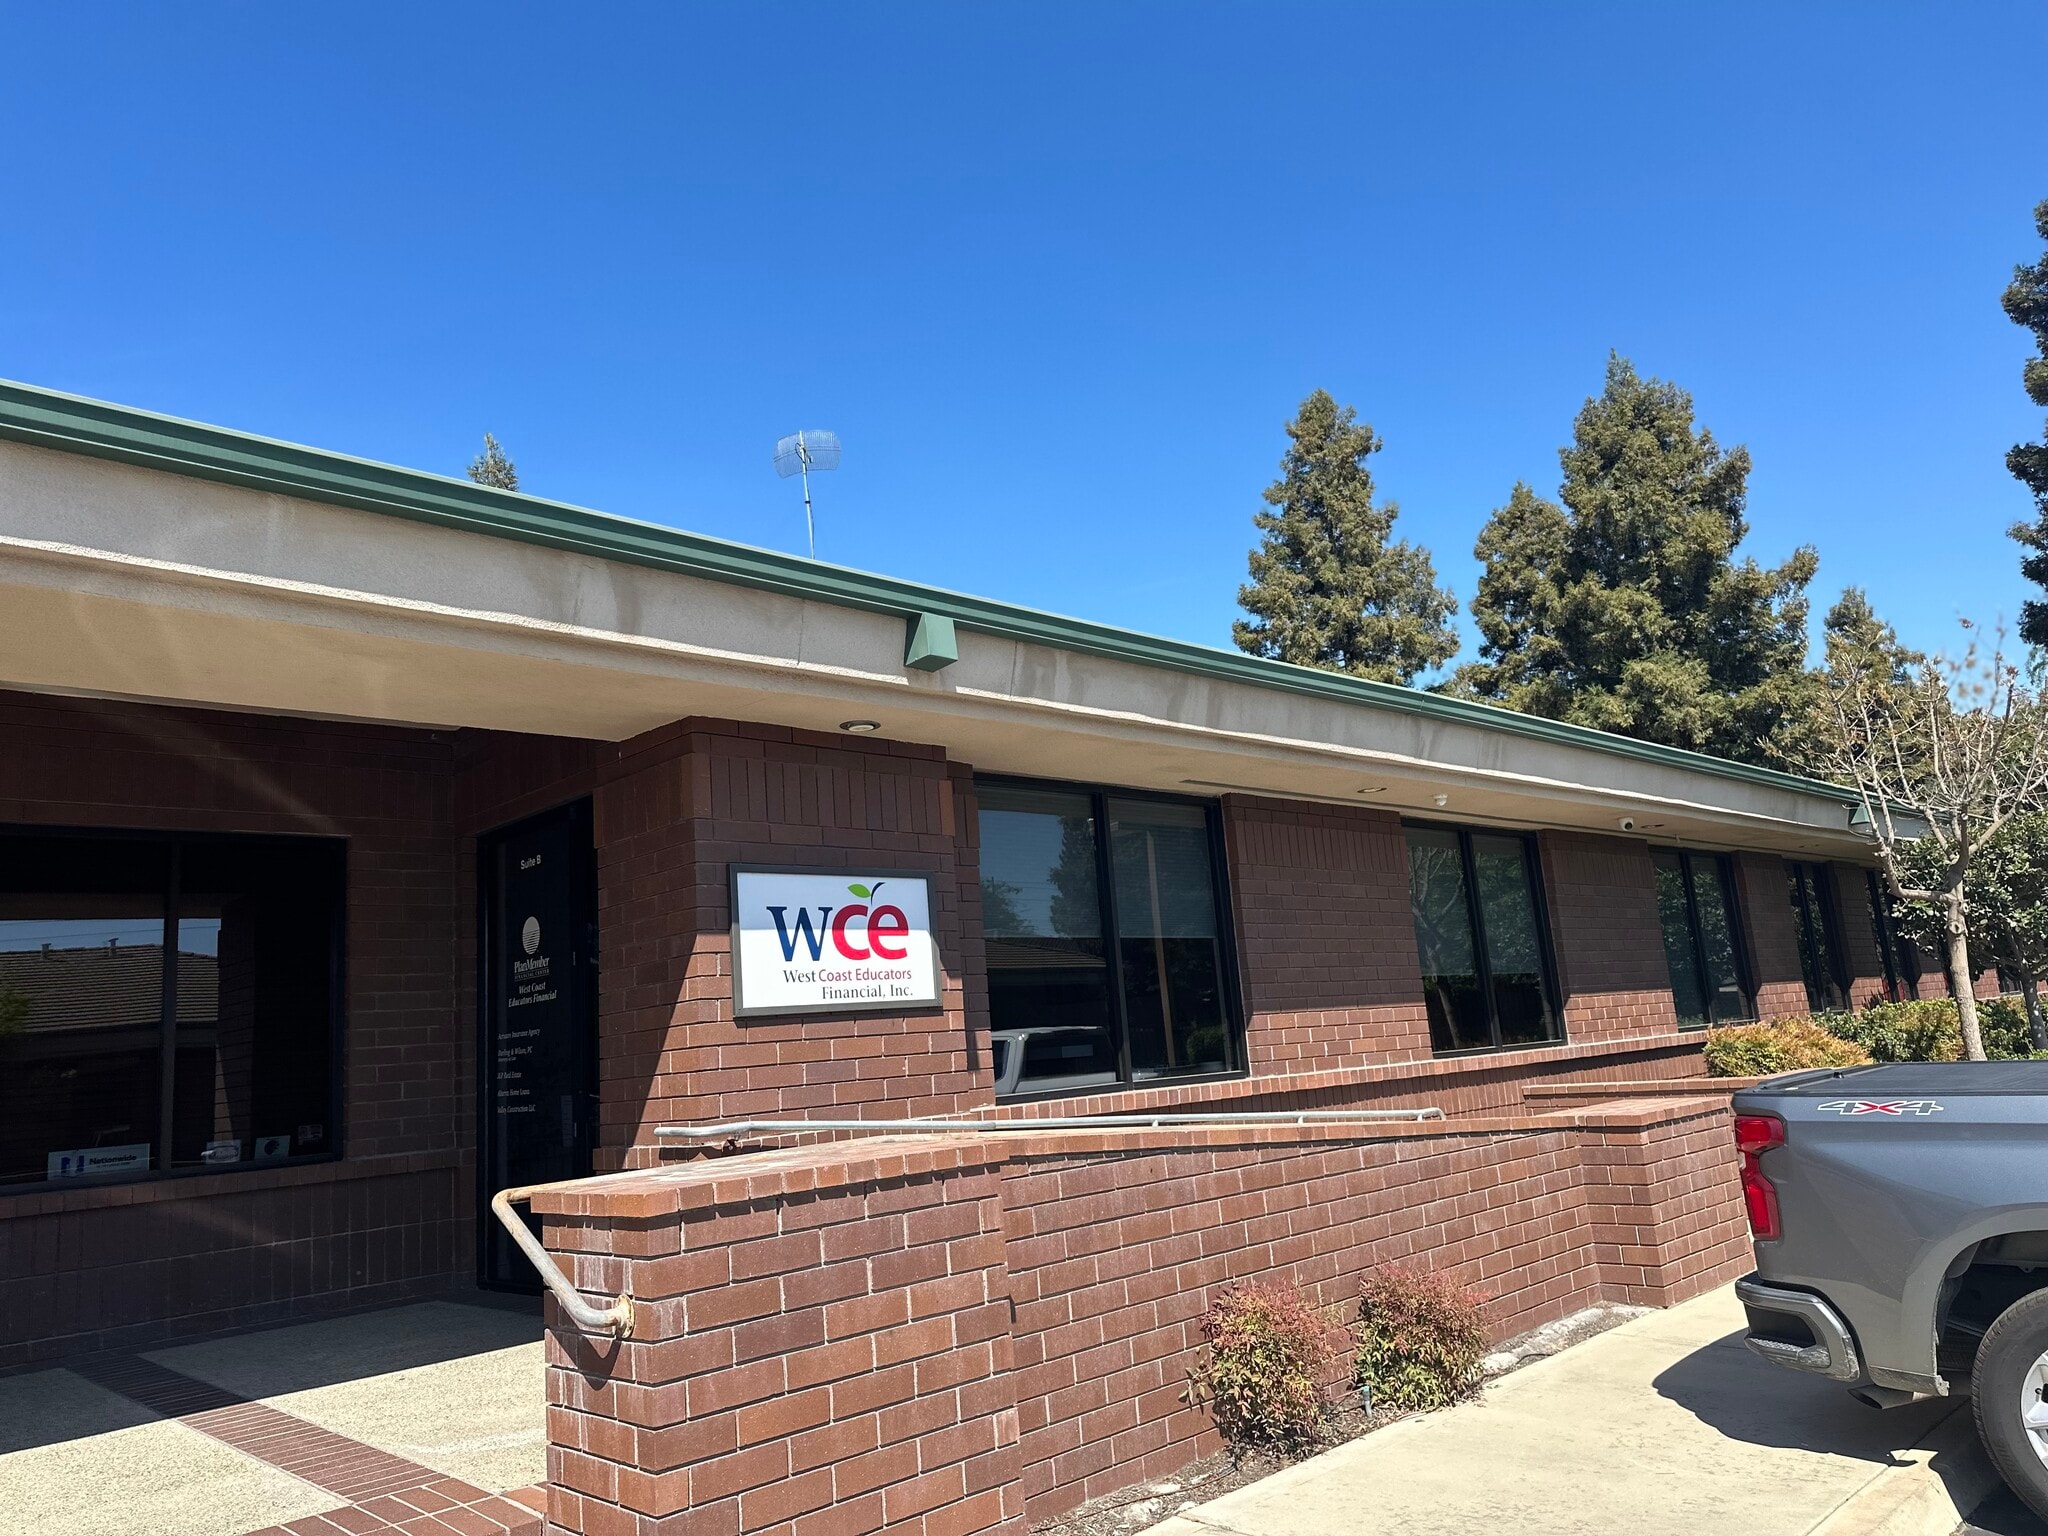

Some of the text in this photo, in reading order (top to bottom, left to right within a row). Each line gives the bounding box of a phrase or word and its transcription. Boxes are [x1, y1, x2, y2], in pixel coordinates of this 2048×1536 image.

[521, 859, 535, 869] Suite
[783, 968, 912, 983] West Coast Educators
[519, 982, 546, 995] West Coast
[822, 984, 913, 1000] Financial, Inc.
[508, 990, 557, 1008] Educators Financial
